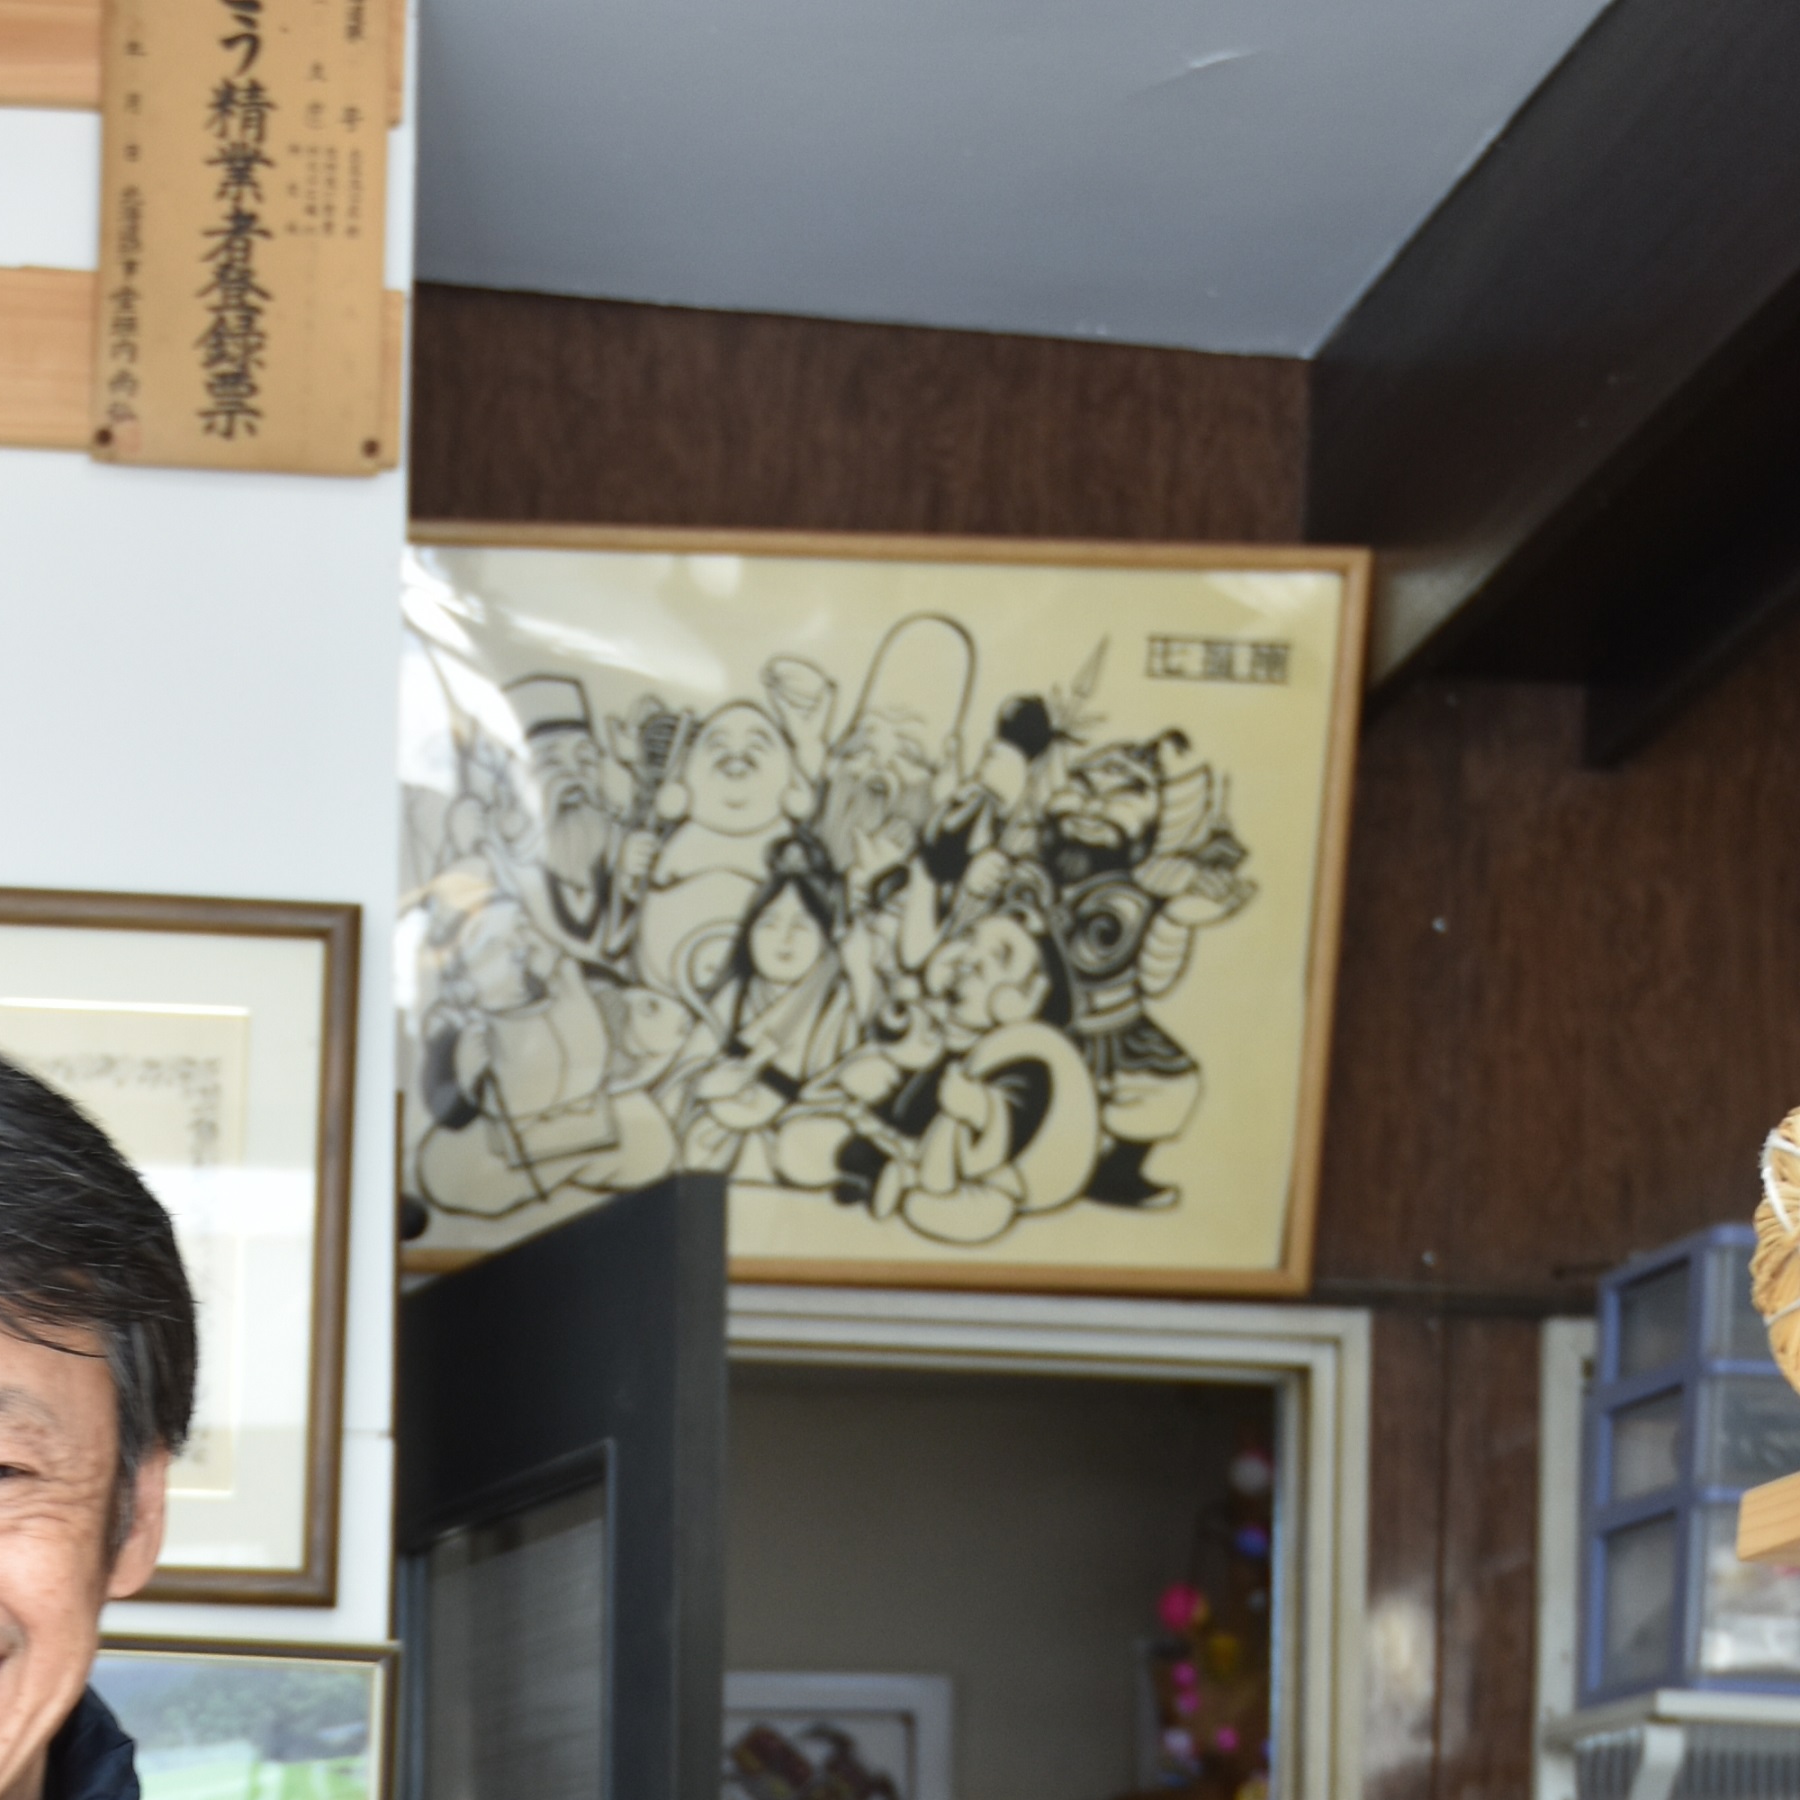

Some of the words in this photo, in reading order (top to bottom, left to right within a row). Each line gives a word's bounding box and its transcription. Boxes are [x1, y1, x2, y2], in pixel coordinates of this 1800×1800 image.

[194, 0, 277, 441] う精業者登録票
